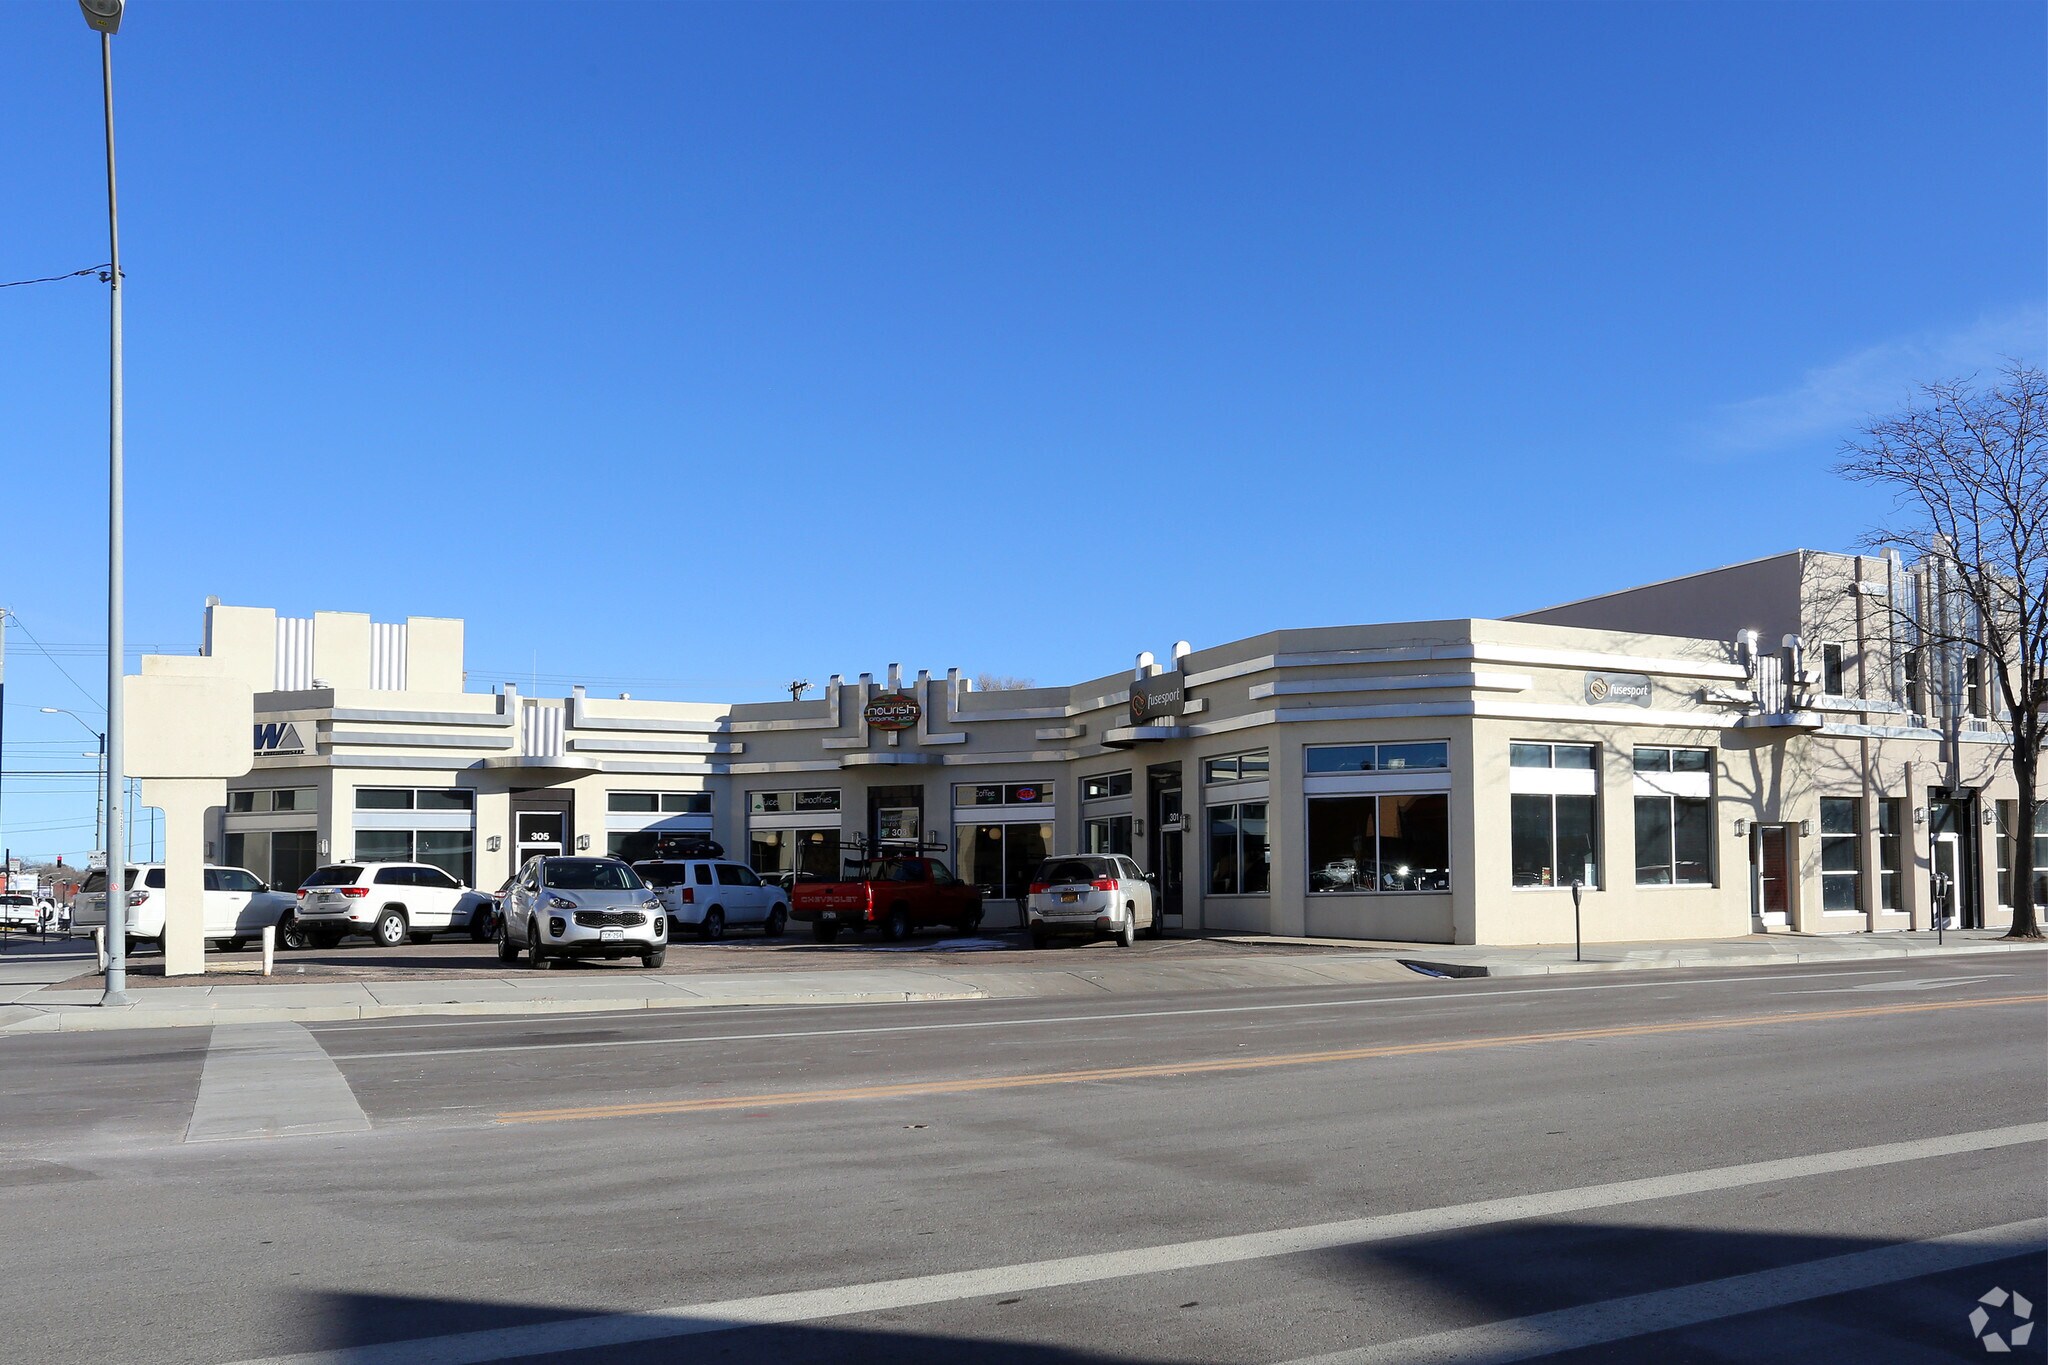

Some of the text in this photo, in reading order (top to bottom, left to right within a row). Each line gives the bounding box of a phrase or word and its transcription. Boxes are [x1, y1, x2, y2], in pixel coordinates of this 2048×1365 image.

[1610, 684, 1648, 697] fusesport
[1147, 687, 1180, 710] fusesport
[867, 704, 916, 716] nourish
[800, 795, 833, 805] Smoothies
[1169, 812, 1179, 822] 301
[530, 831, 550, 841] 305
[891, 828, 908, 837] 303
